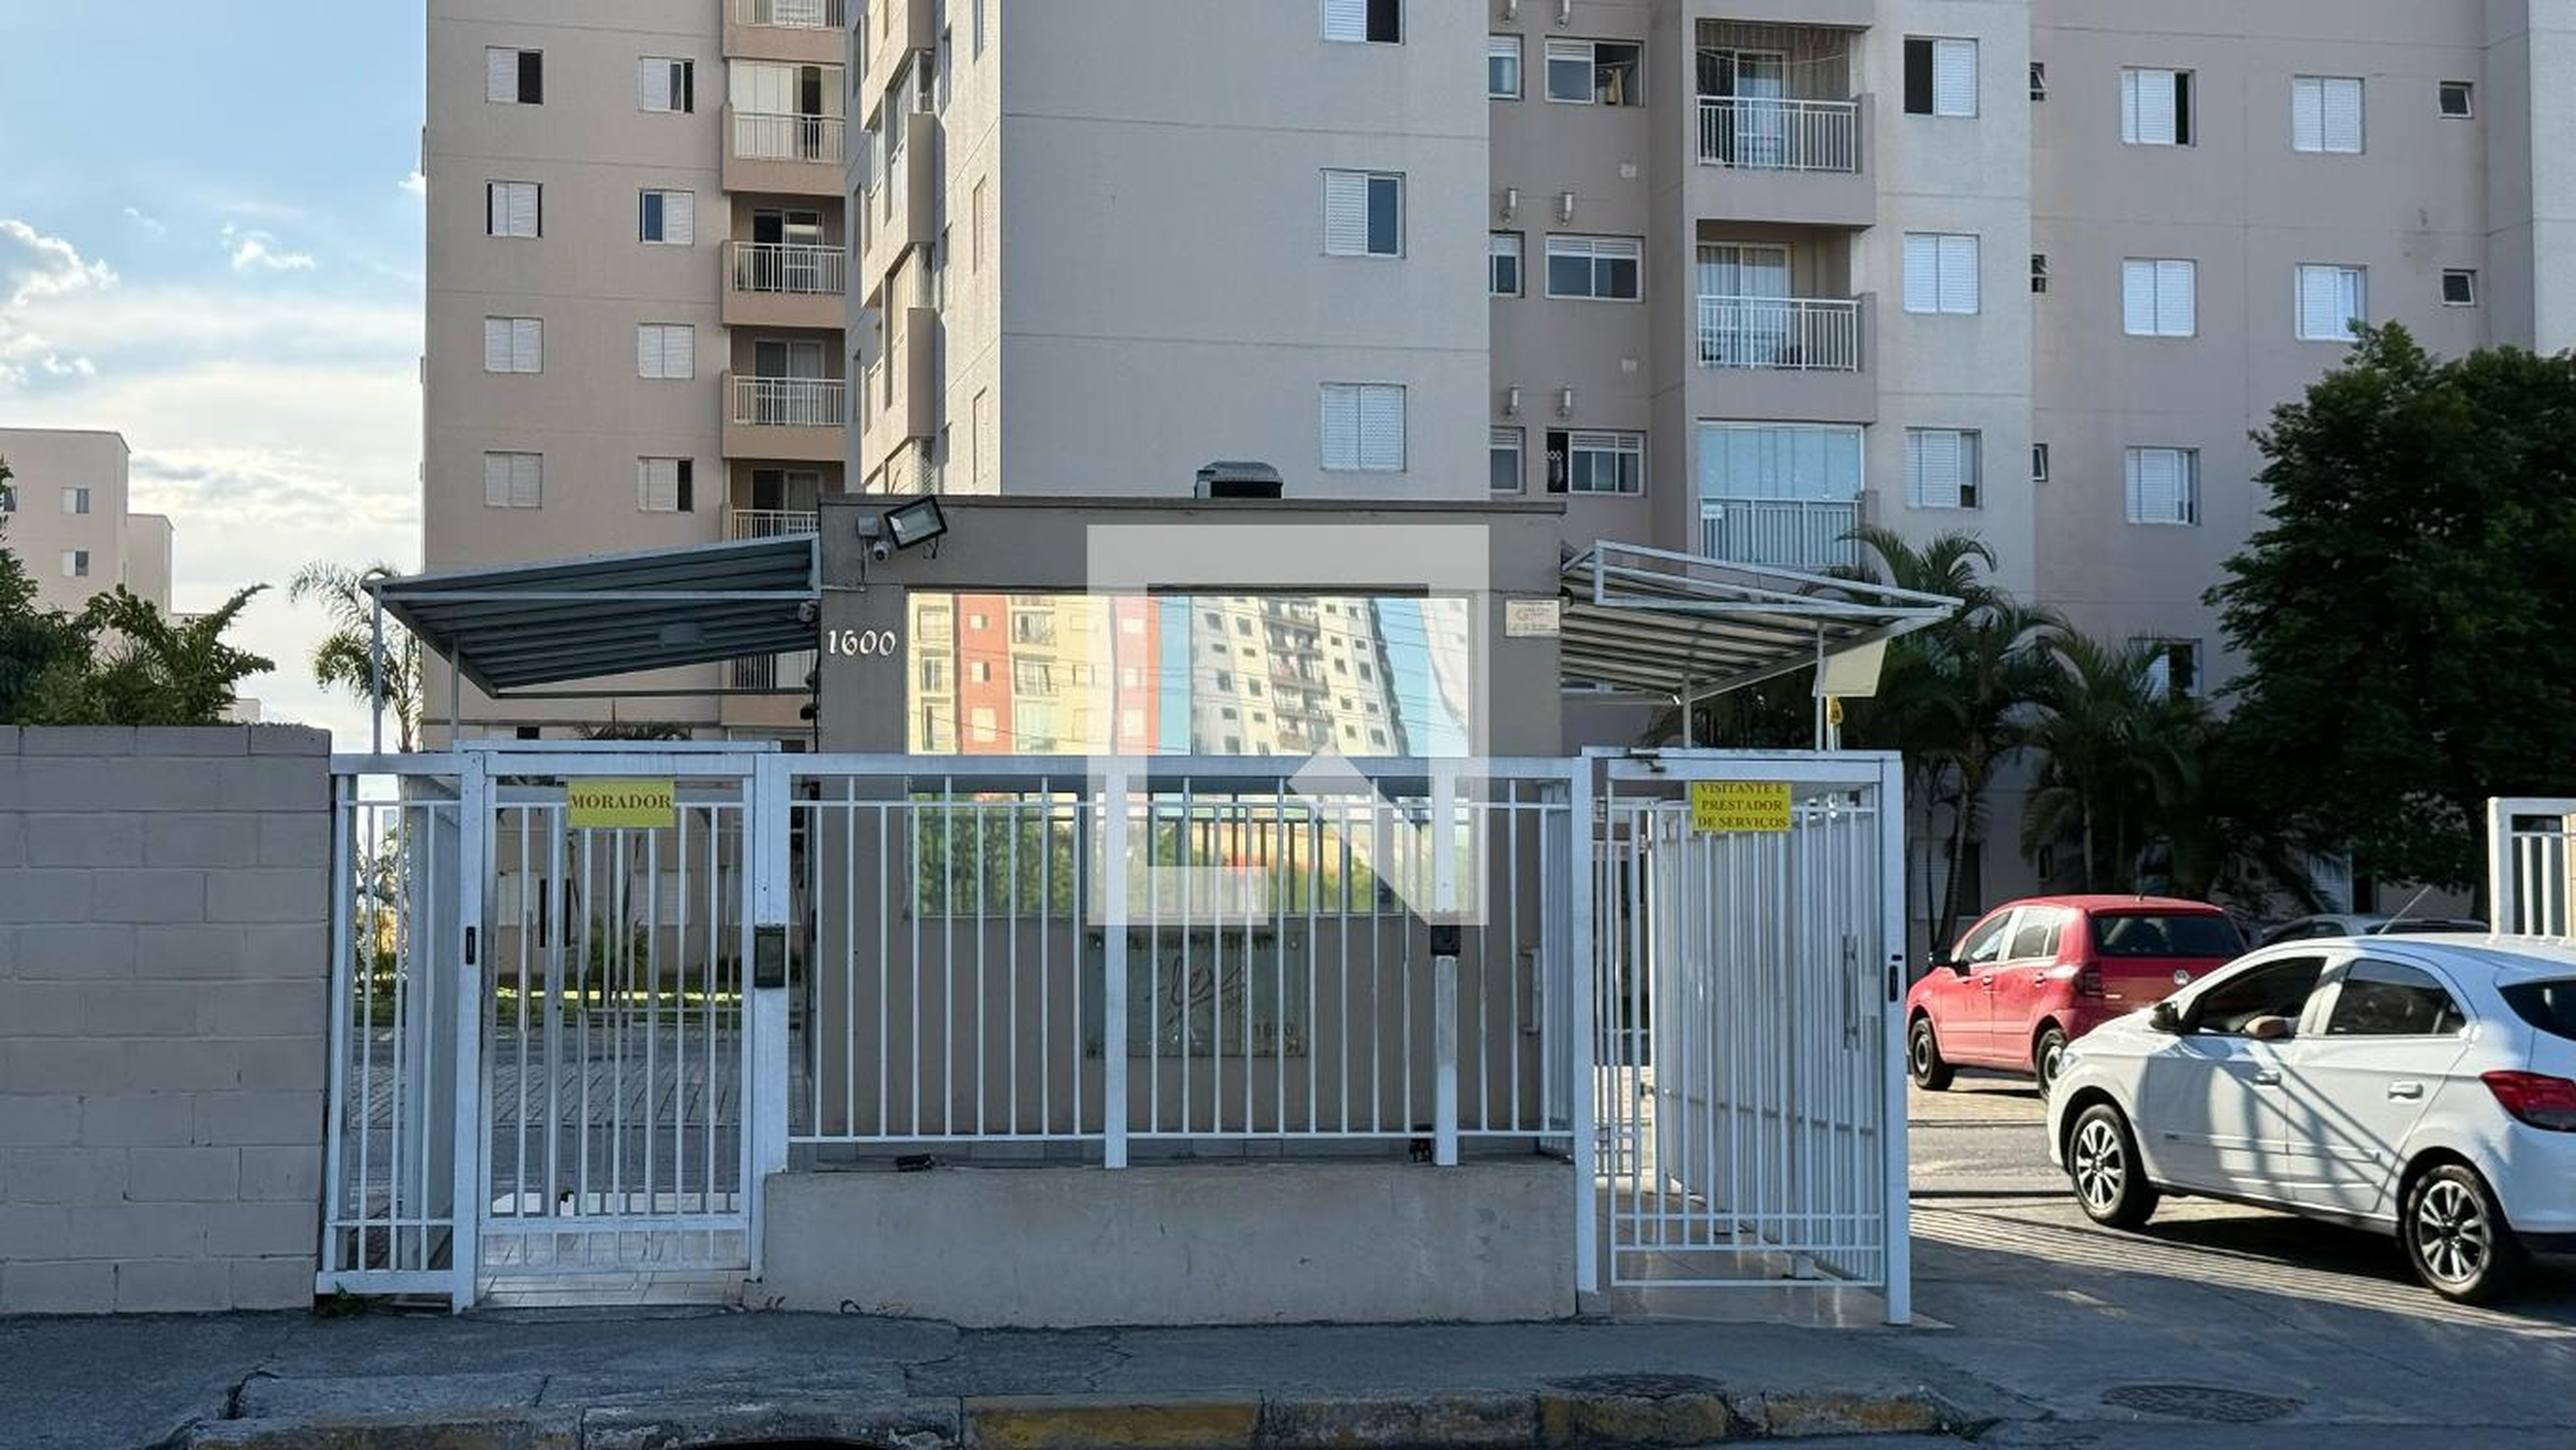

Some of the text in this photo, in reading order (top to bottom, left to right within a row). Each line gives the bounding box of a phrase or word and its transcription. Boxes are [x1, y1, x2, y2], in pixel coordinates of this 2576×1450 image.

[828, 629, 896, 656] 1600
[1701, 783, 1786, 794] VISITANTE E
[572, 794, 671, 809] MORADOR
[1702, 800, 1782, 811] PRESTADOR
[1698, 817, 1715, 827] DE
